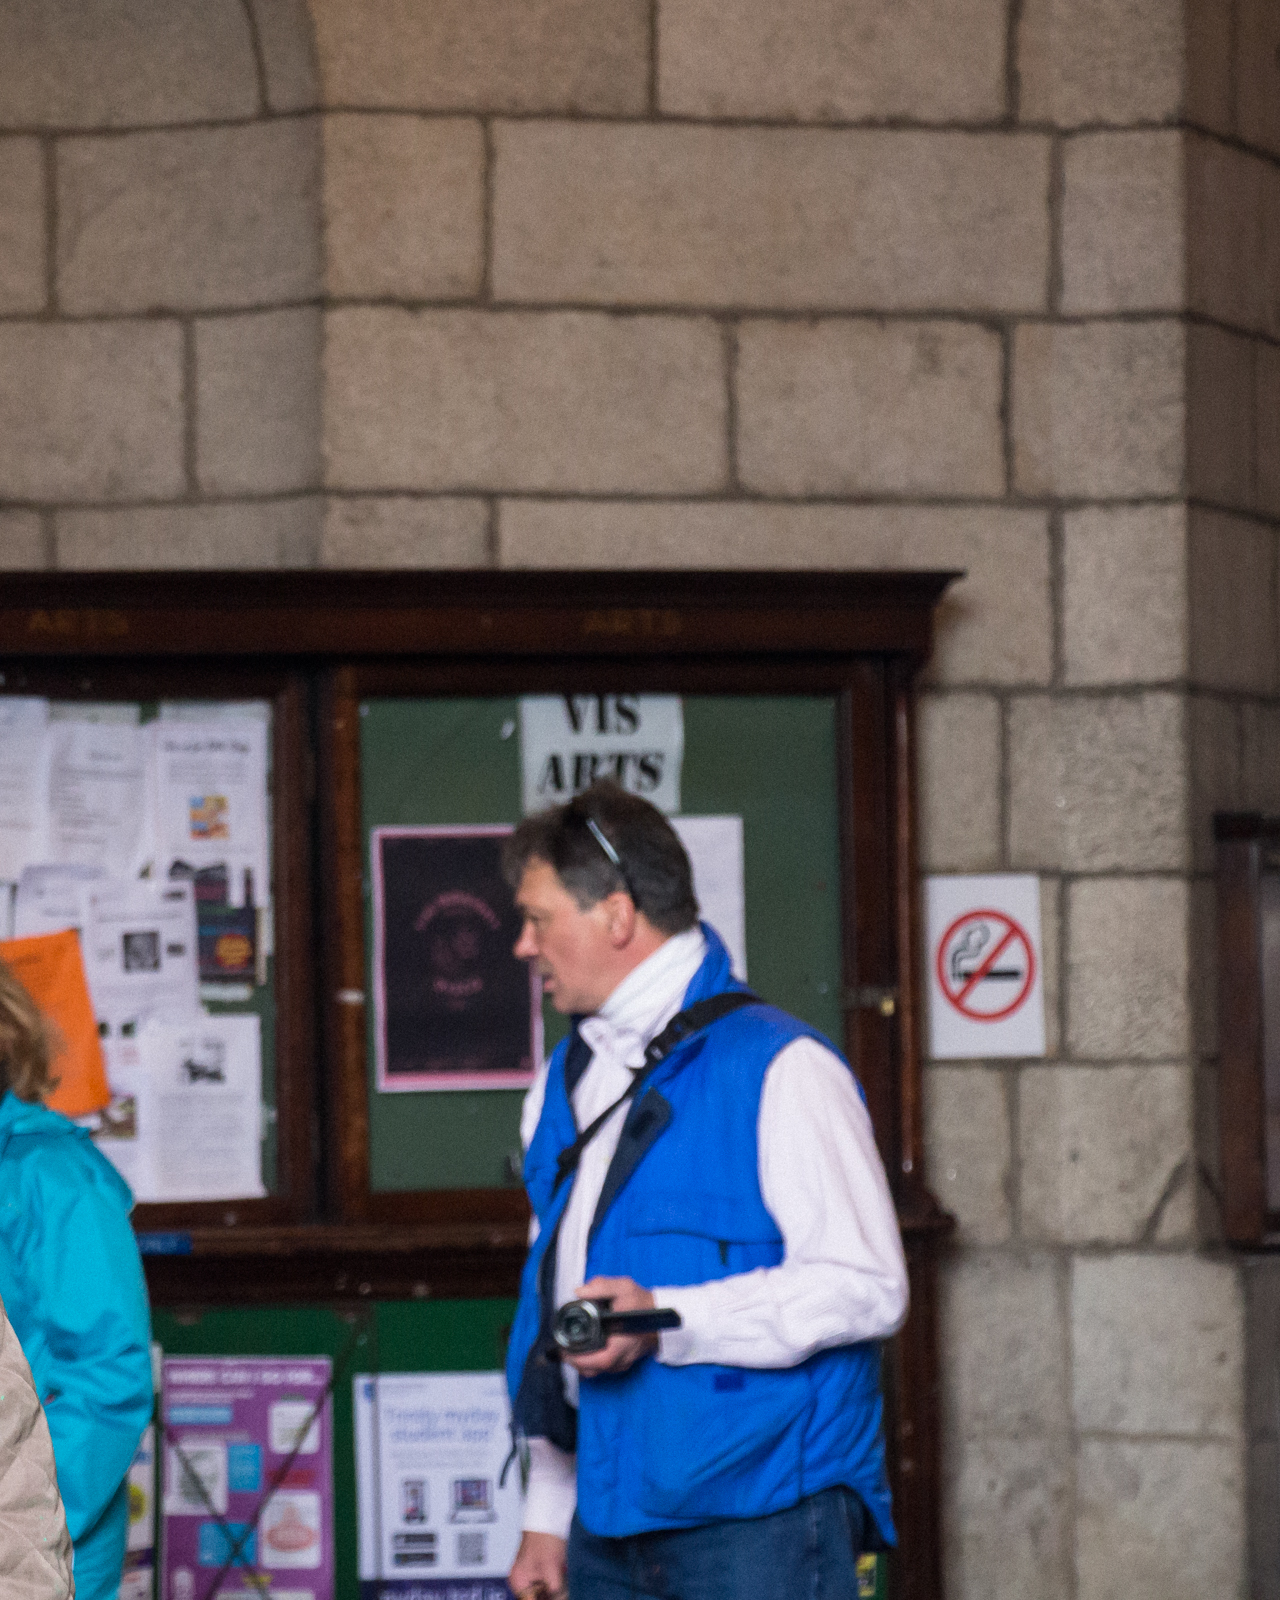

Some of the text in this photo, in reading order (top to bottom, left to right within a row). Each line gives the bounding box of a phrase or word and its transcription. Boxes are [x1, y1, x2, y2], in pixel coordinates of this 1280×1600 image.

[28, 608, 130, 636] ARTS
[583, 608, 682, 636] ARTS
[563, 694, 641, 735] VIS
[535, 751, 666, 793] ARTS
